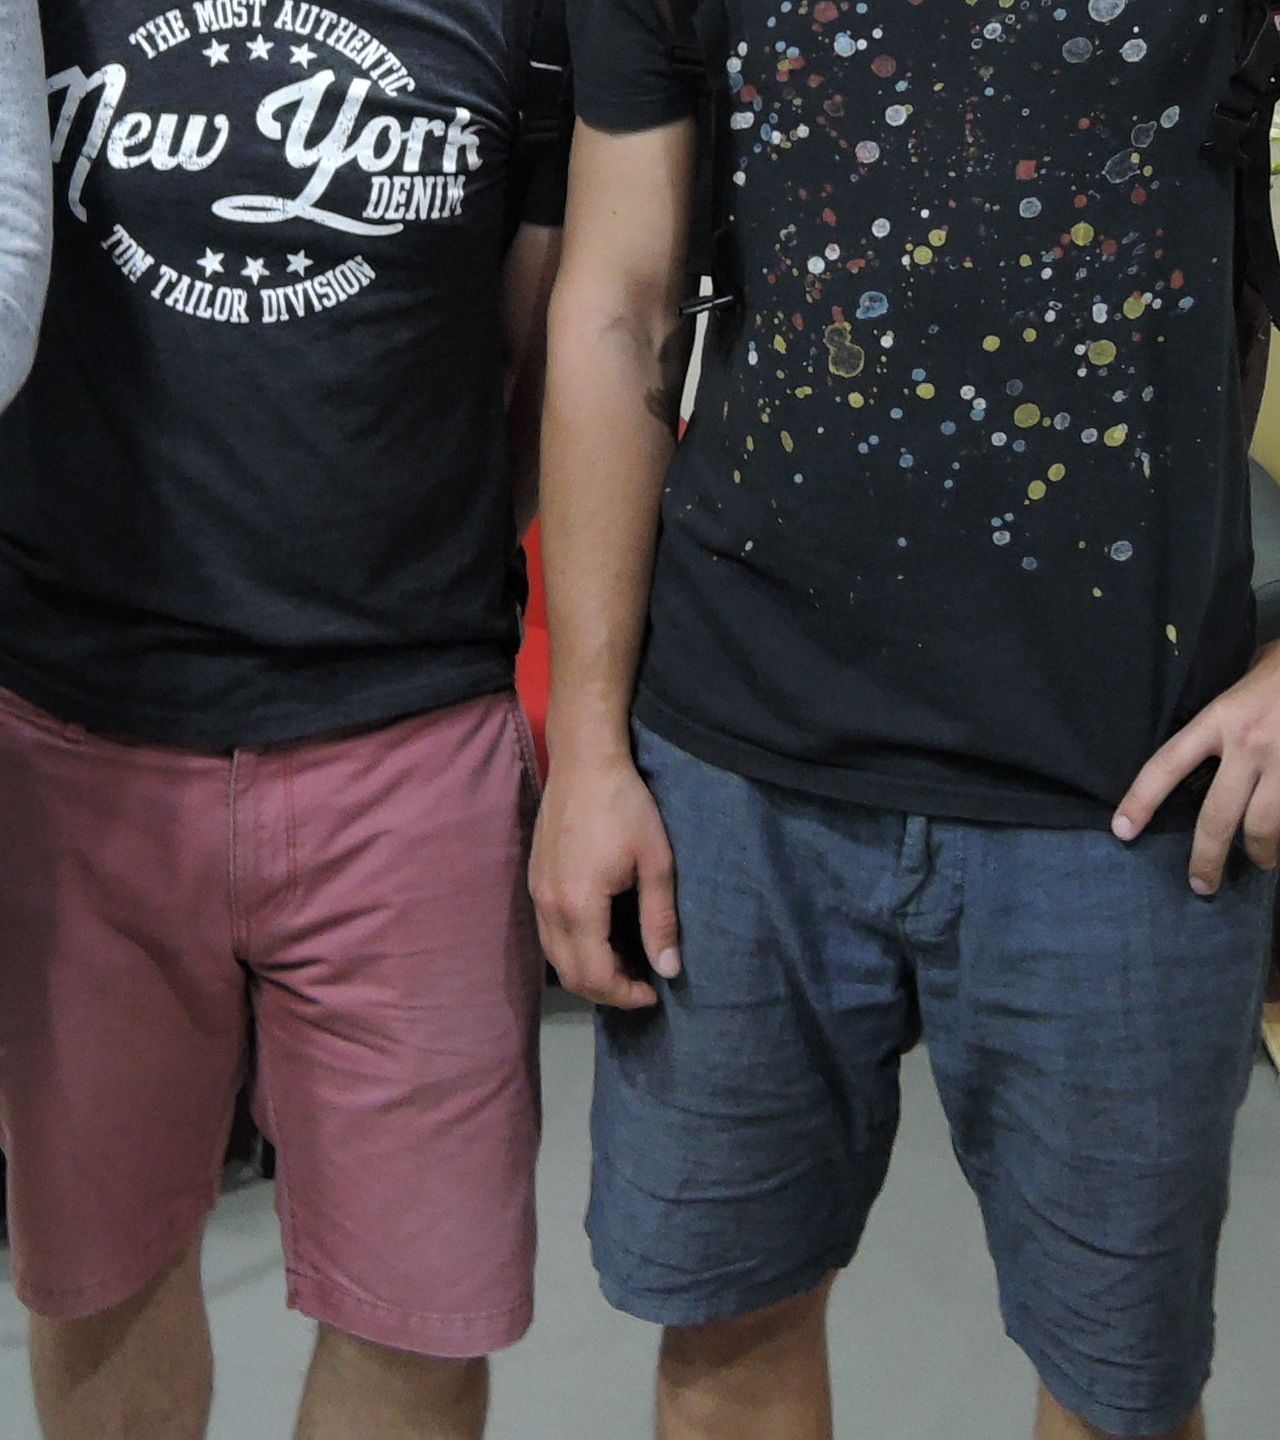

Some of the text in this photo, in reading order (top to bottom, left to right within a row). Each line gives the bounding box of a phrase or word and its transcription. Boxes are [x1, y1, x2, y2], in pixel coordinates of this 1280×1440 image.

[128, 12, 191, 60] THE
[46, 62, 485, 237] New York
[362, 174, 467, 222] DENIM
[100, 223, 377, 325] TOM TAILOR DIVISION
